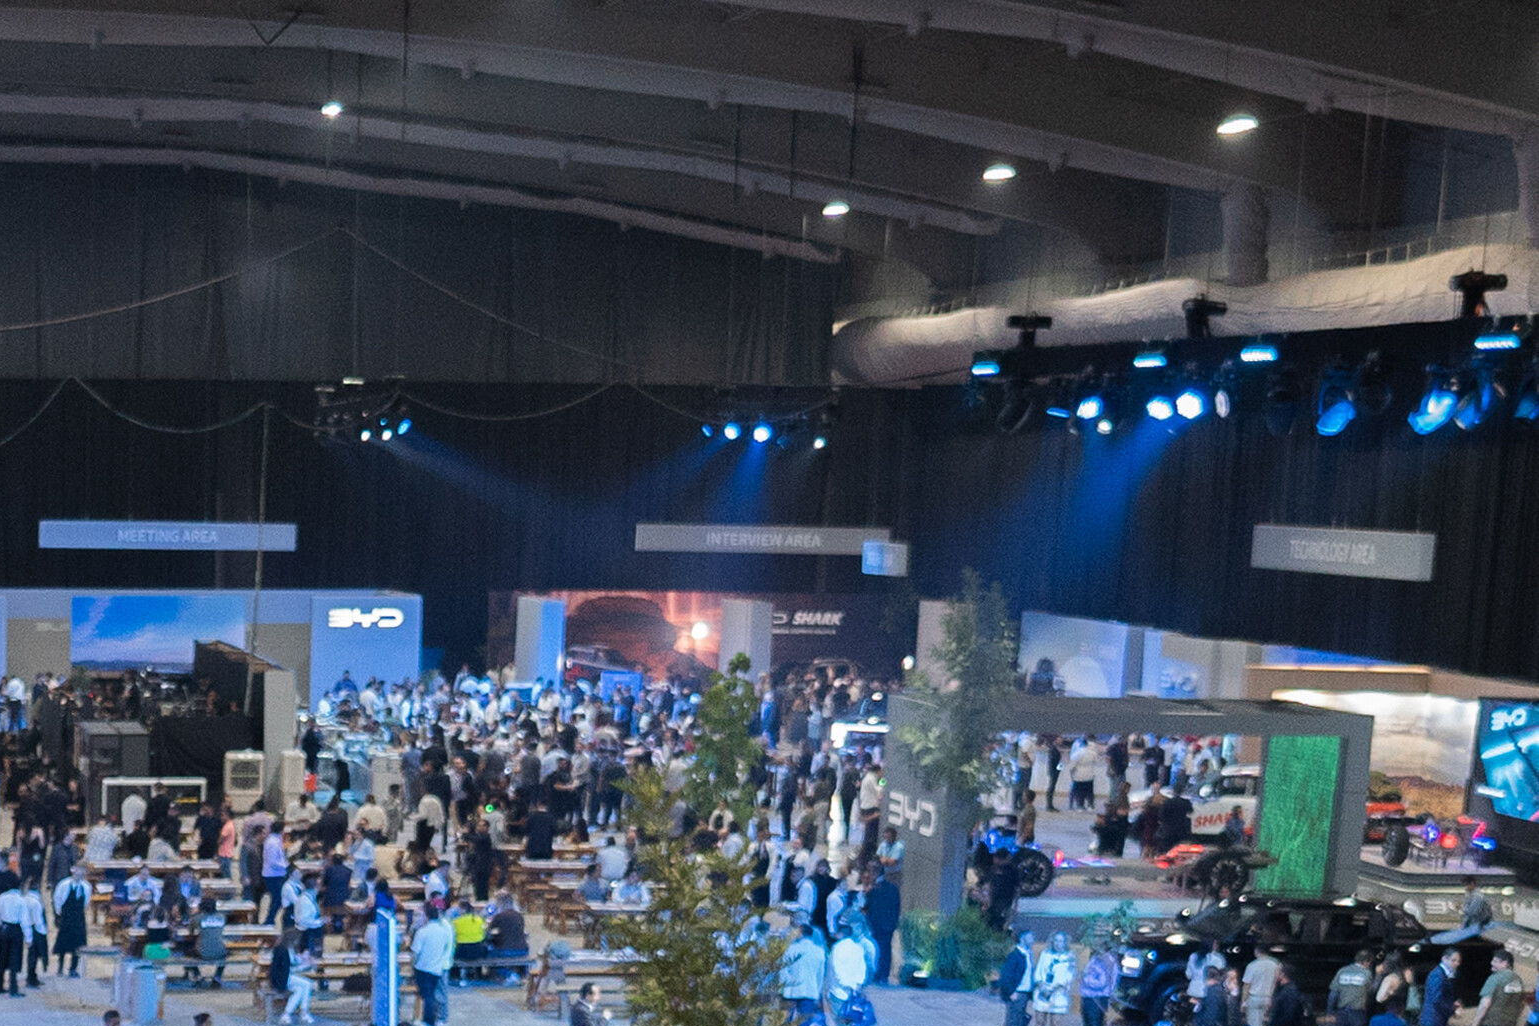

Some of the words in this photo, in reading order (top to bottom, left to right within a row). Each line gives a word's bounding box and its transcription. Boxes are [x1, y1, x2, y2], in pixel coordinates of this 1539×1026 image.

[117, 529, 179, 543] MEETING
[183, 531, 218, 544] AREA
[706, 532, 783, 547] INTERVIEW
[784, 534, 821, 548] AREA
[328, 607, 404, 629] BYD
[792, 611, 844, 626] SHARK
[1491, 708, 1527, 731] BYD
[888, 791, 936, 837] BYD
